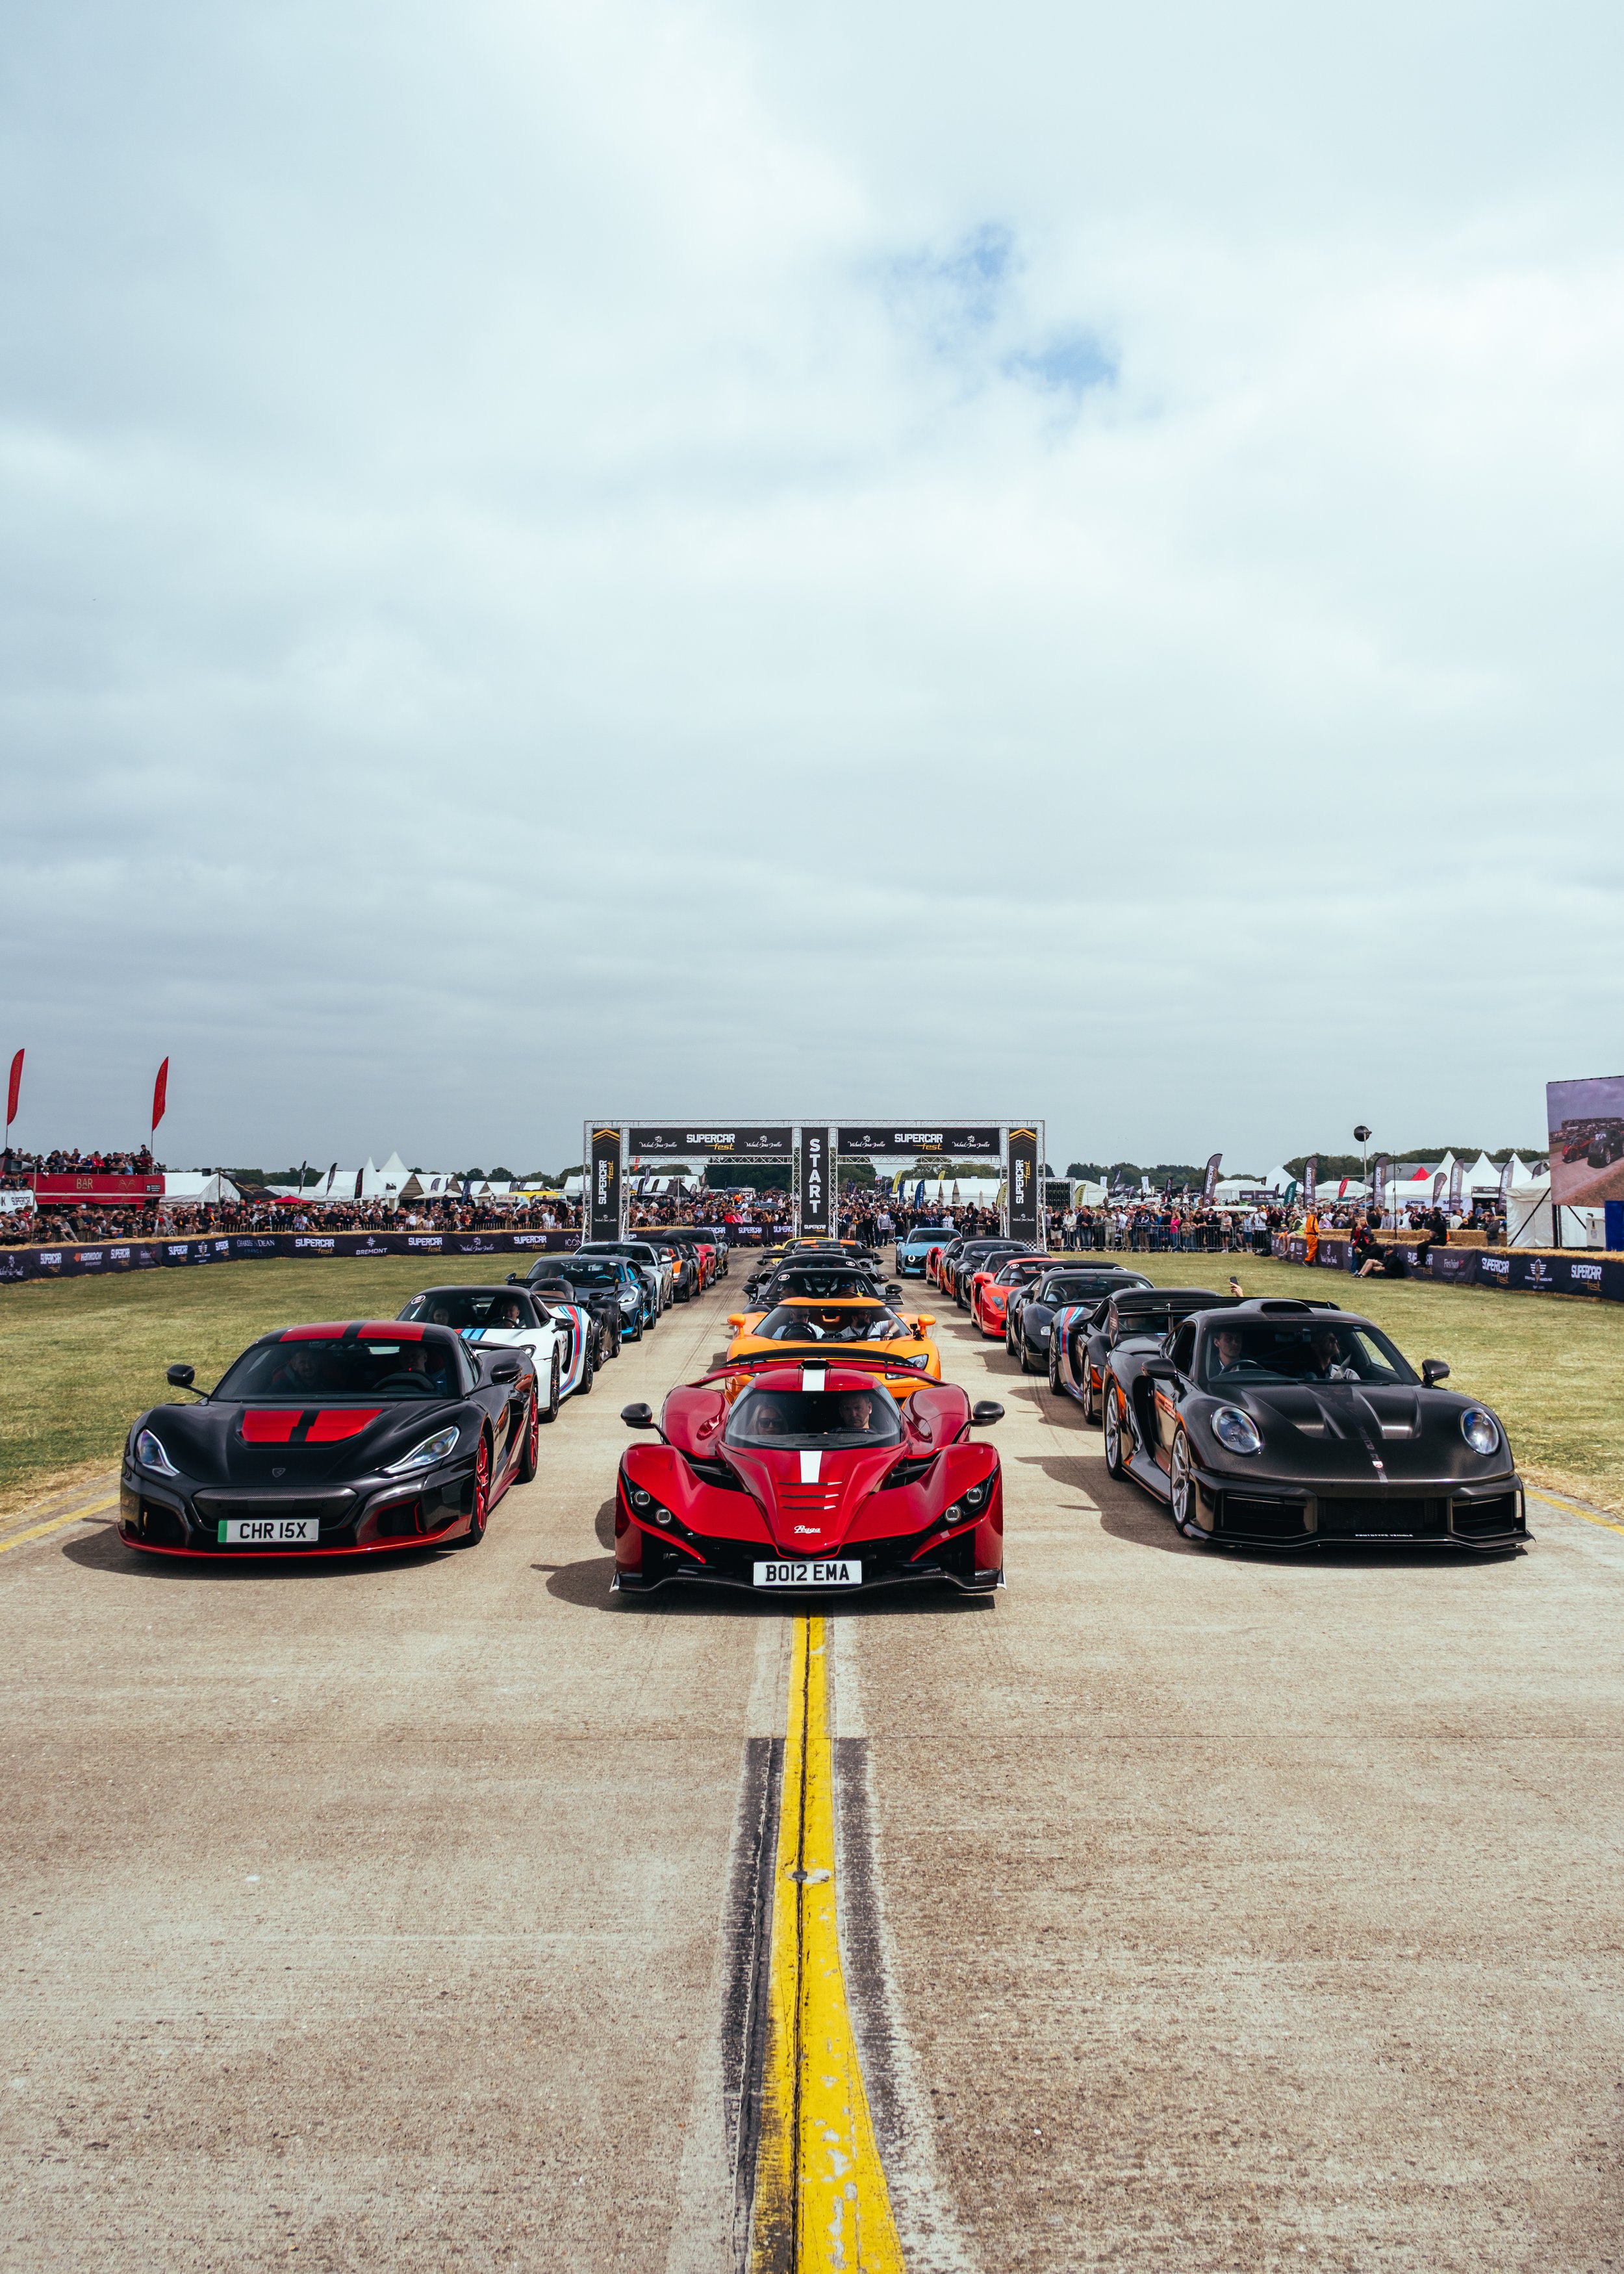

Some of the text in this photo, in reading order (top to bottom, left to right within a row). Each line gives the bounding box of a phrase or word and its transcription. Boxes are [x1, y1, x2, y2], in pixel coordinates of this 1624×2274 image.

[687, 1133, 735, 1143] SUPERCAR
[894, 1133, 943, 1143] SUPERCAR
[77, 1178, 93, 1189] BAR
[598, 1160, 607, 1205] SUPERCAR
[808, 1138, 821, 1214] START
[1015, 1159, 1024, 1204] SUPERCAR
[1206, 1165, 1215, 1194] SUPERCAR
[295, 1238, 335, 1247] SUPERCAR
[408, 1236, 442, 1246] SUPERCAR
[514, 1236, 547, 1244] SUPERCAR
[1408, 1252, 1432, 1265] SUPAR
[1482, 1257, 1510, 1273] SUPERCAR
[1571, 1264, 1602, 1281] SUPERCAR
[240, 1522, 307, 1539] CHR 15X
[813, 1563, 849, 1581] EMA
